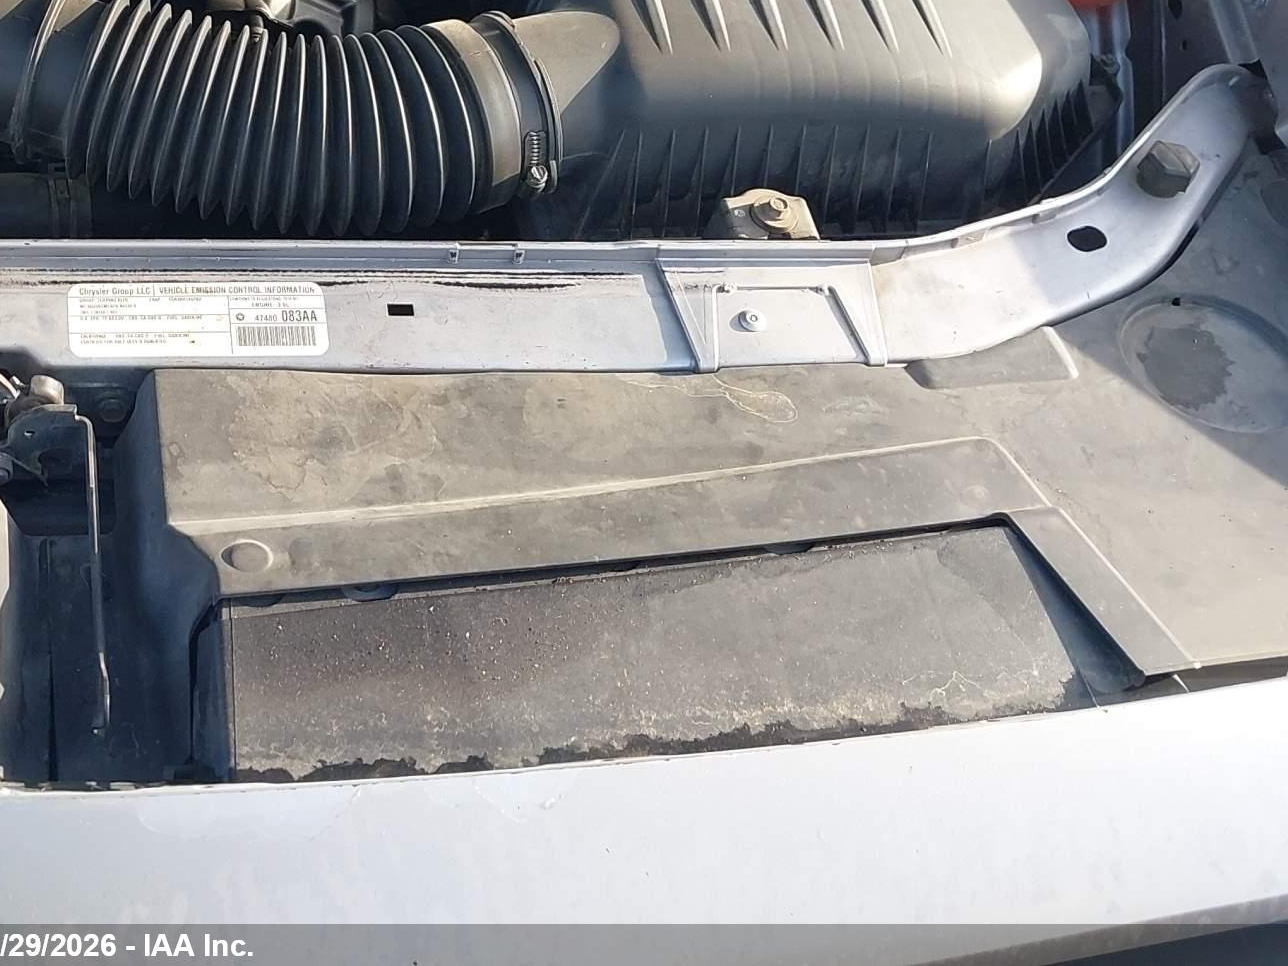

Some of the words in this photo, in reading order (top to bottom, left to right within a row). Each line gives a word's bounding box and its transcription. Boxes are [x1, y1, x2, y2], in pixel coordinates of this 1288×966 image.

[79, 287, 109, 297] Chrysler
[112, 287, 134, 296] Group
[136, 286, 151, 294] LLC
[159, 286, 189, 294] VEHICLE
[191, 286, 226, 294] EMISSION
[228, 286, 262, 294] CONTROL
[264, 285, 315, 294] INFORMATION
[281, 310, 318, 322] 083AA
